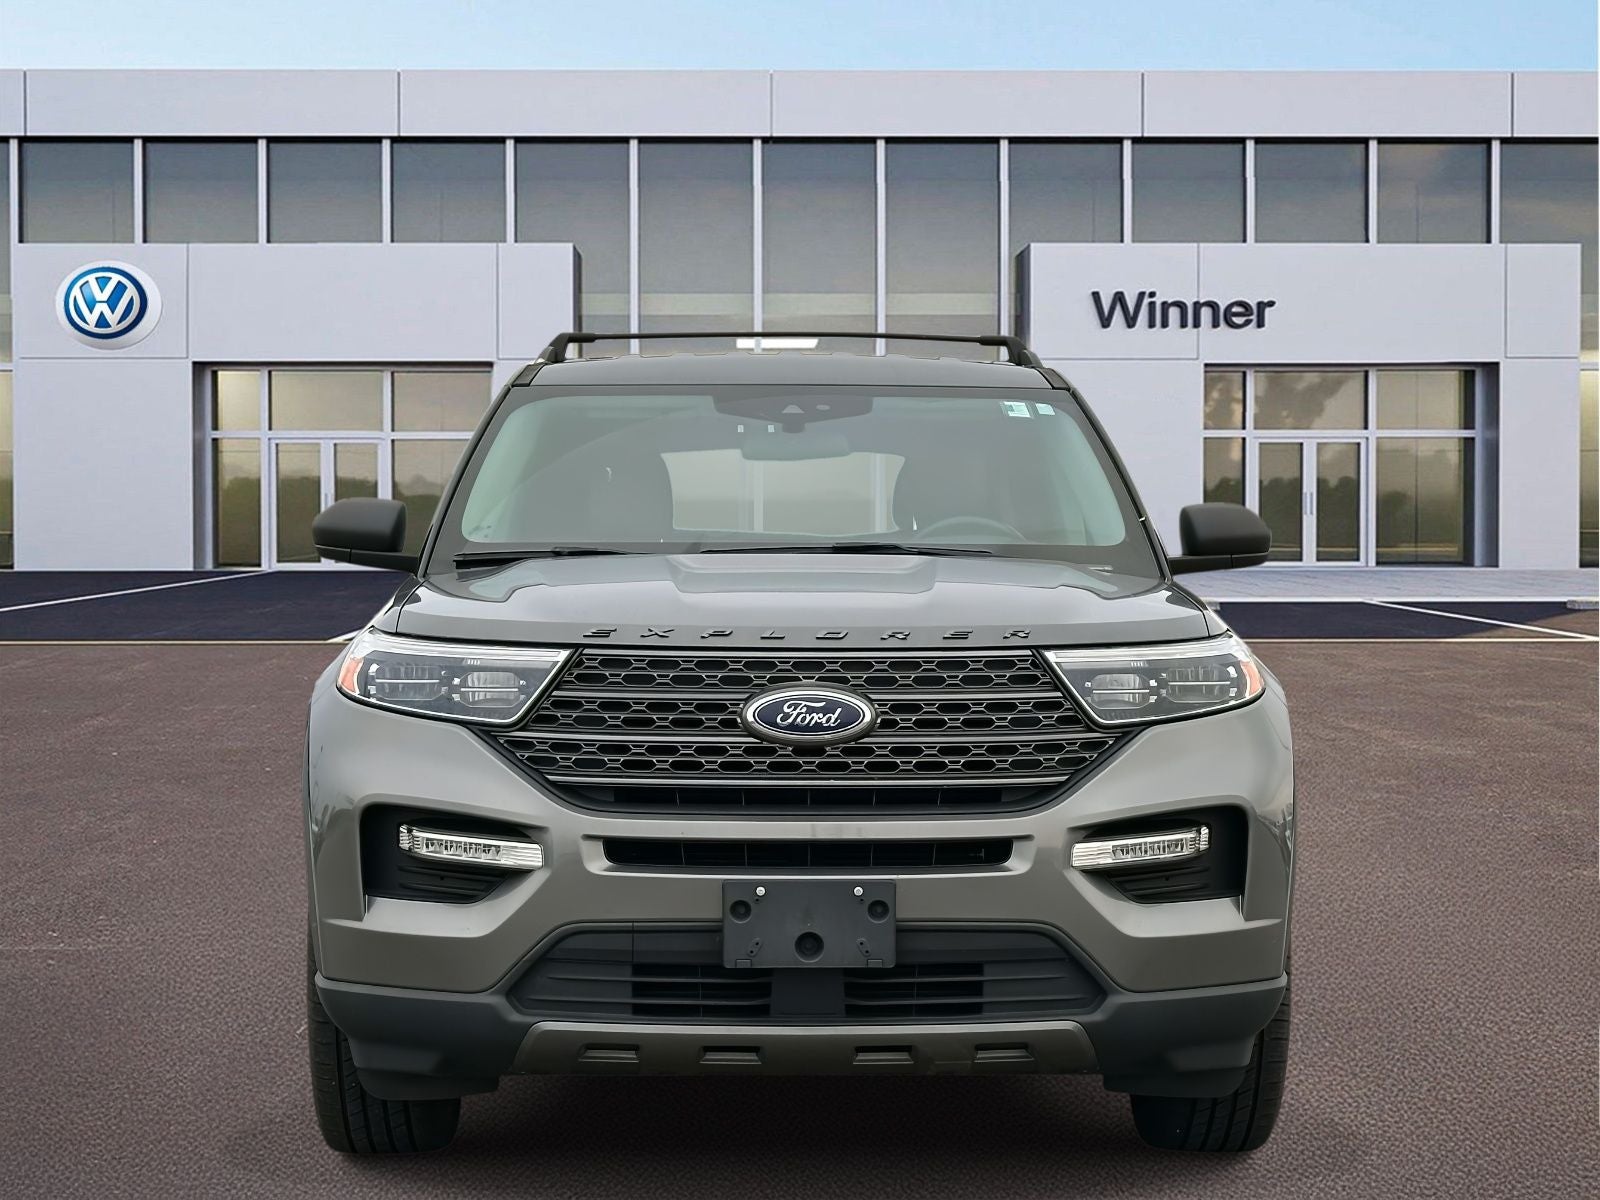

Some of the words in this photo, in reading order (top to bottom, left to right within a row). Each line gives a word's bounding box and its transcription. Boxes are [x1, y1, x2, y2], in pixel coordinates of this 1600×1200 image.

[1091, 290, 1276, 330] Winner
[582, 627, 1031, 640] EXPLORER
[776, 700, 842, 727] Ford
